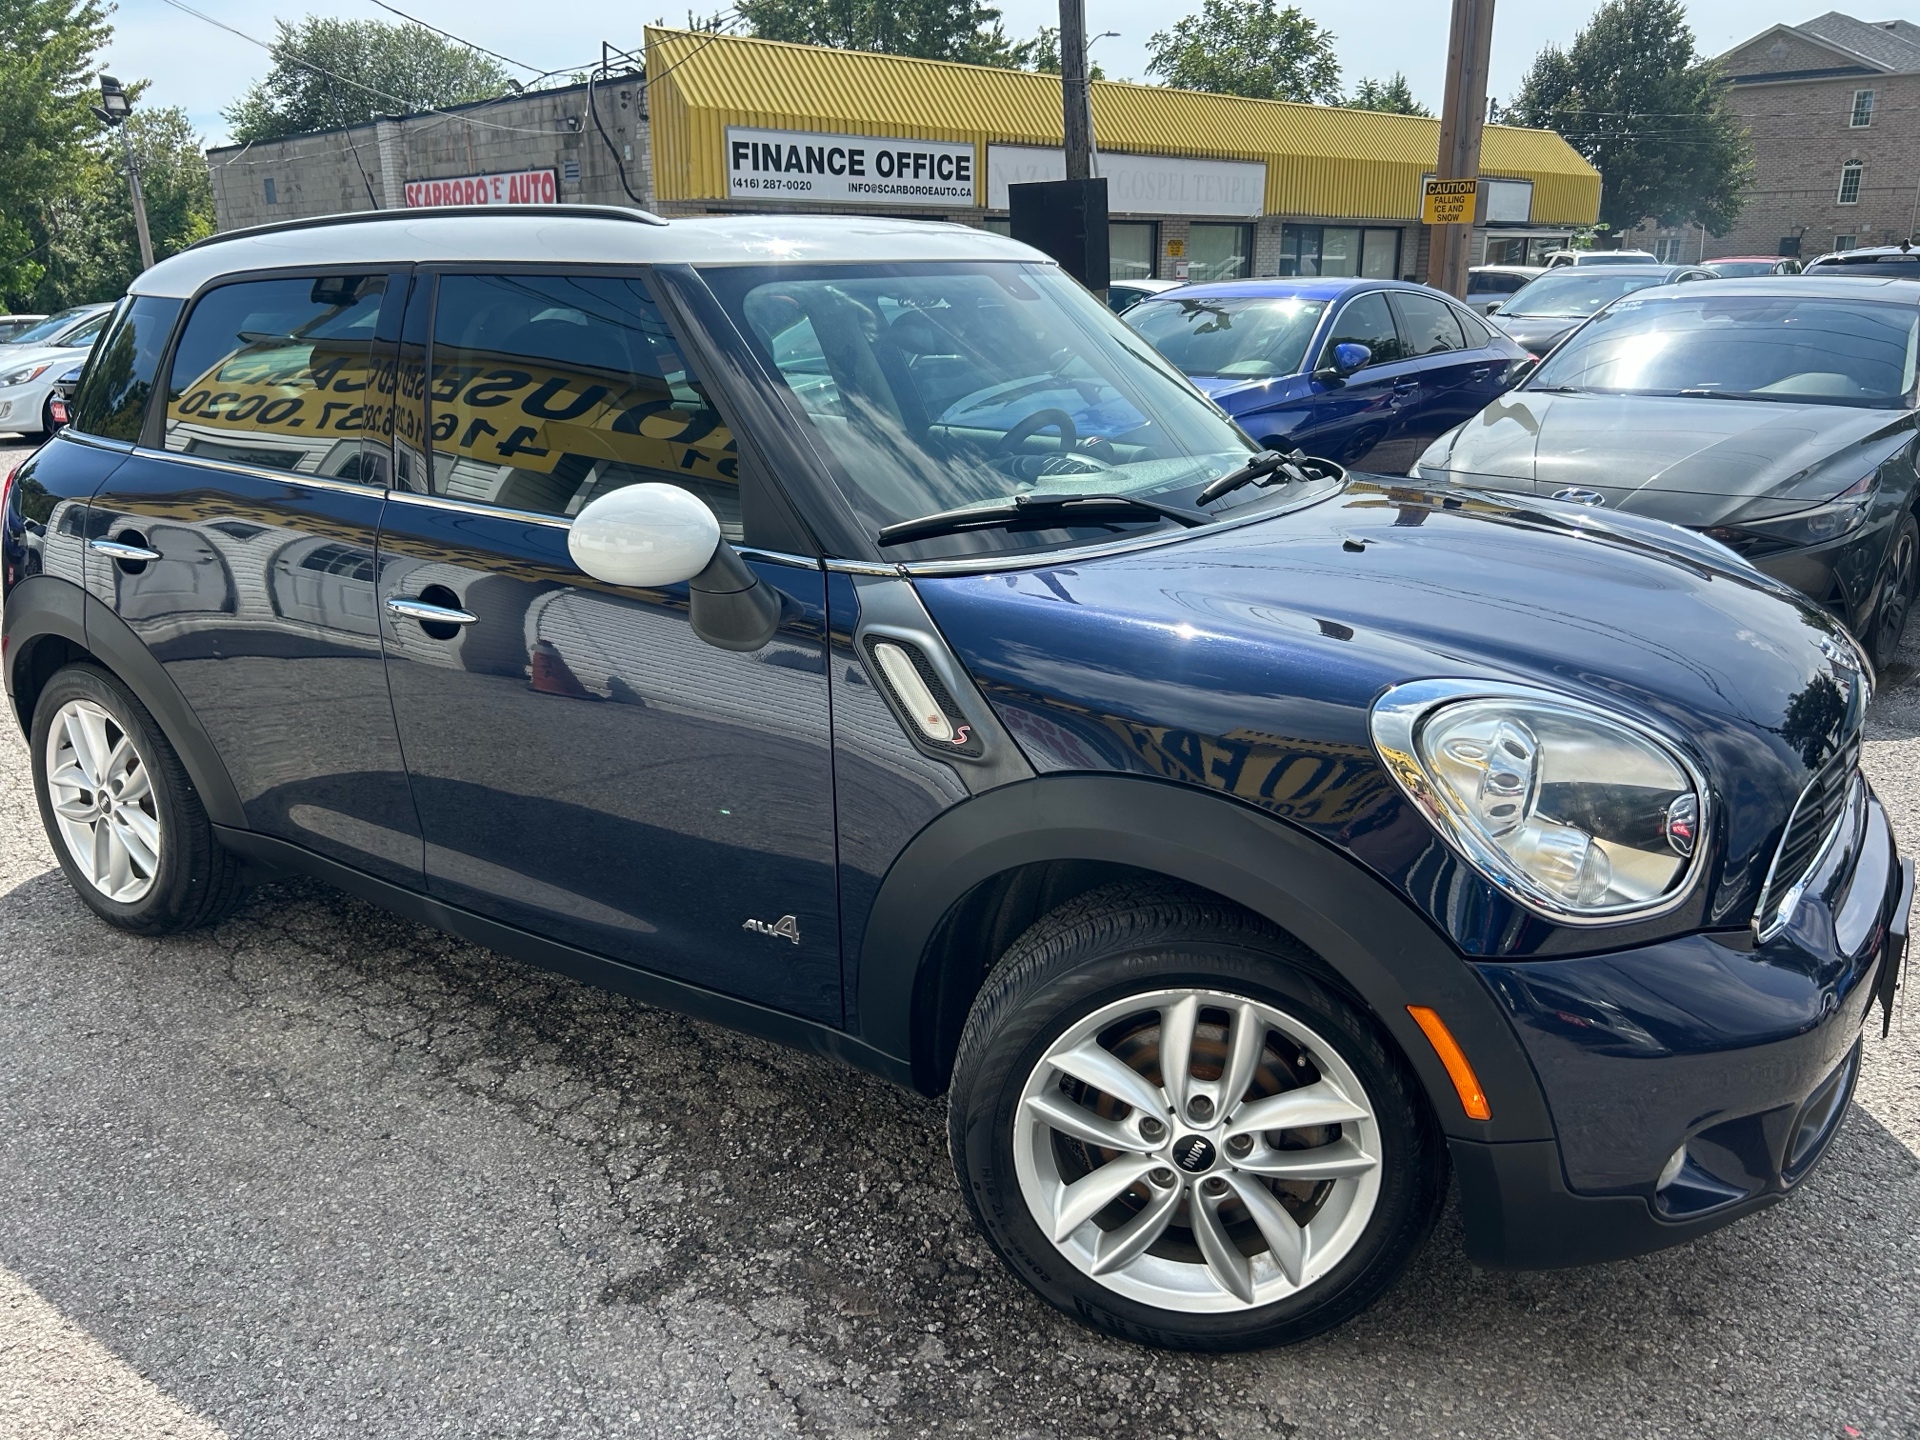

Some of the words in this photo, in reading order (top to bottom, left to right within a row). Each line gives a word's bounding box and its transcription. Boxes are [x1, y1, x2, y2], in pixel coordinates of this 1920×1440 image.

[732, 141, 865, 176] FINANCE
[875, 150, 971, 182] OFFICE
[407, 178, 488, 207] SCARBORO
[509, 171, 555, 204] AUTO
[732, 178, 760, 189] (416)
[763, 179, 812, 191] 287-0020
[848, 183, 972, 197] INFO@SCARBOROEAUTO.CA
[1116, 169, 1187, 201] GOSPEL
[1193, 174, 1261, 204] TEMPLE
[1428, 182, 1474, 194] CAUTION
[1434, 195, 1465, 204] FALLING
[1434, 205, 1446, 213] ICE
[1447, 204, 1464, 213] AND
[1437, 213, 1460, 222] SNOW
[1182, 1140, 1207, 1168] MINI
